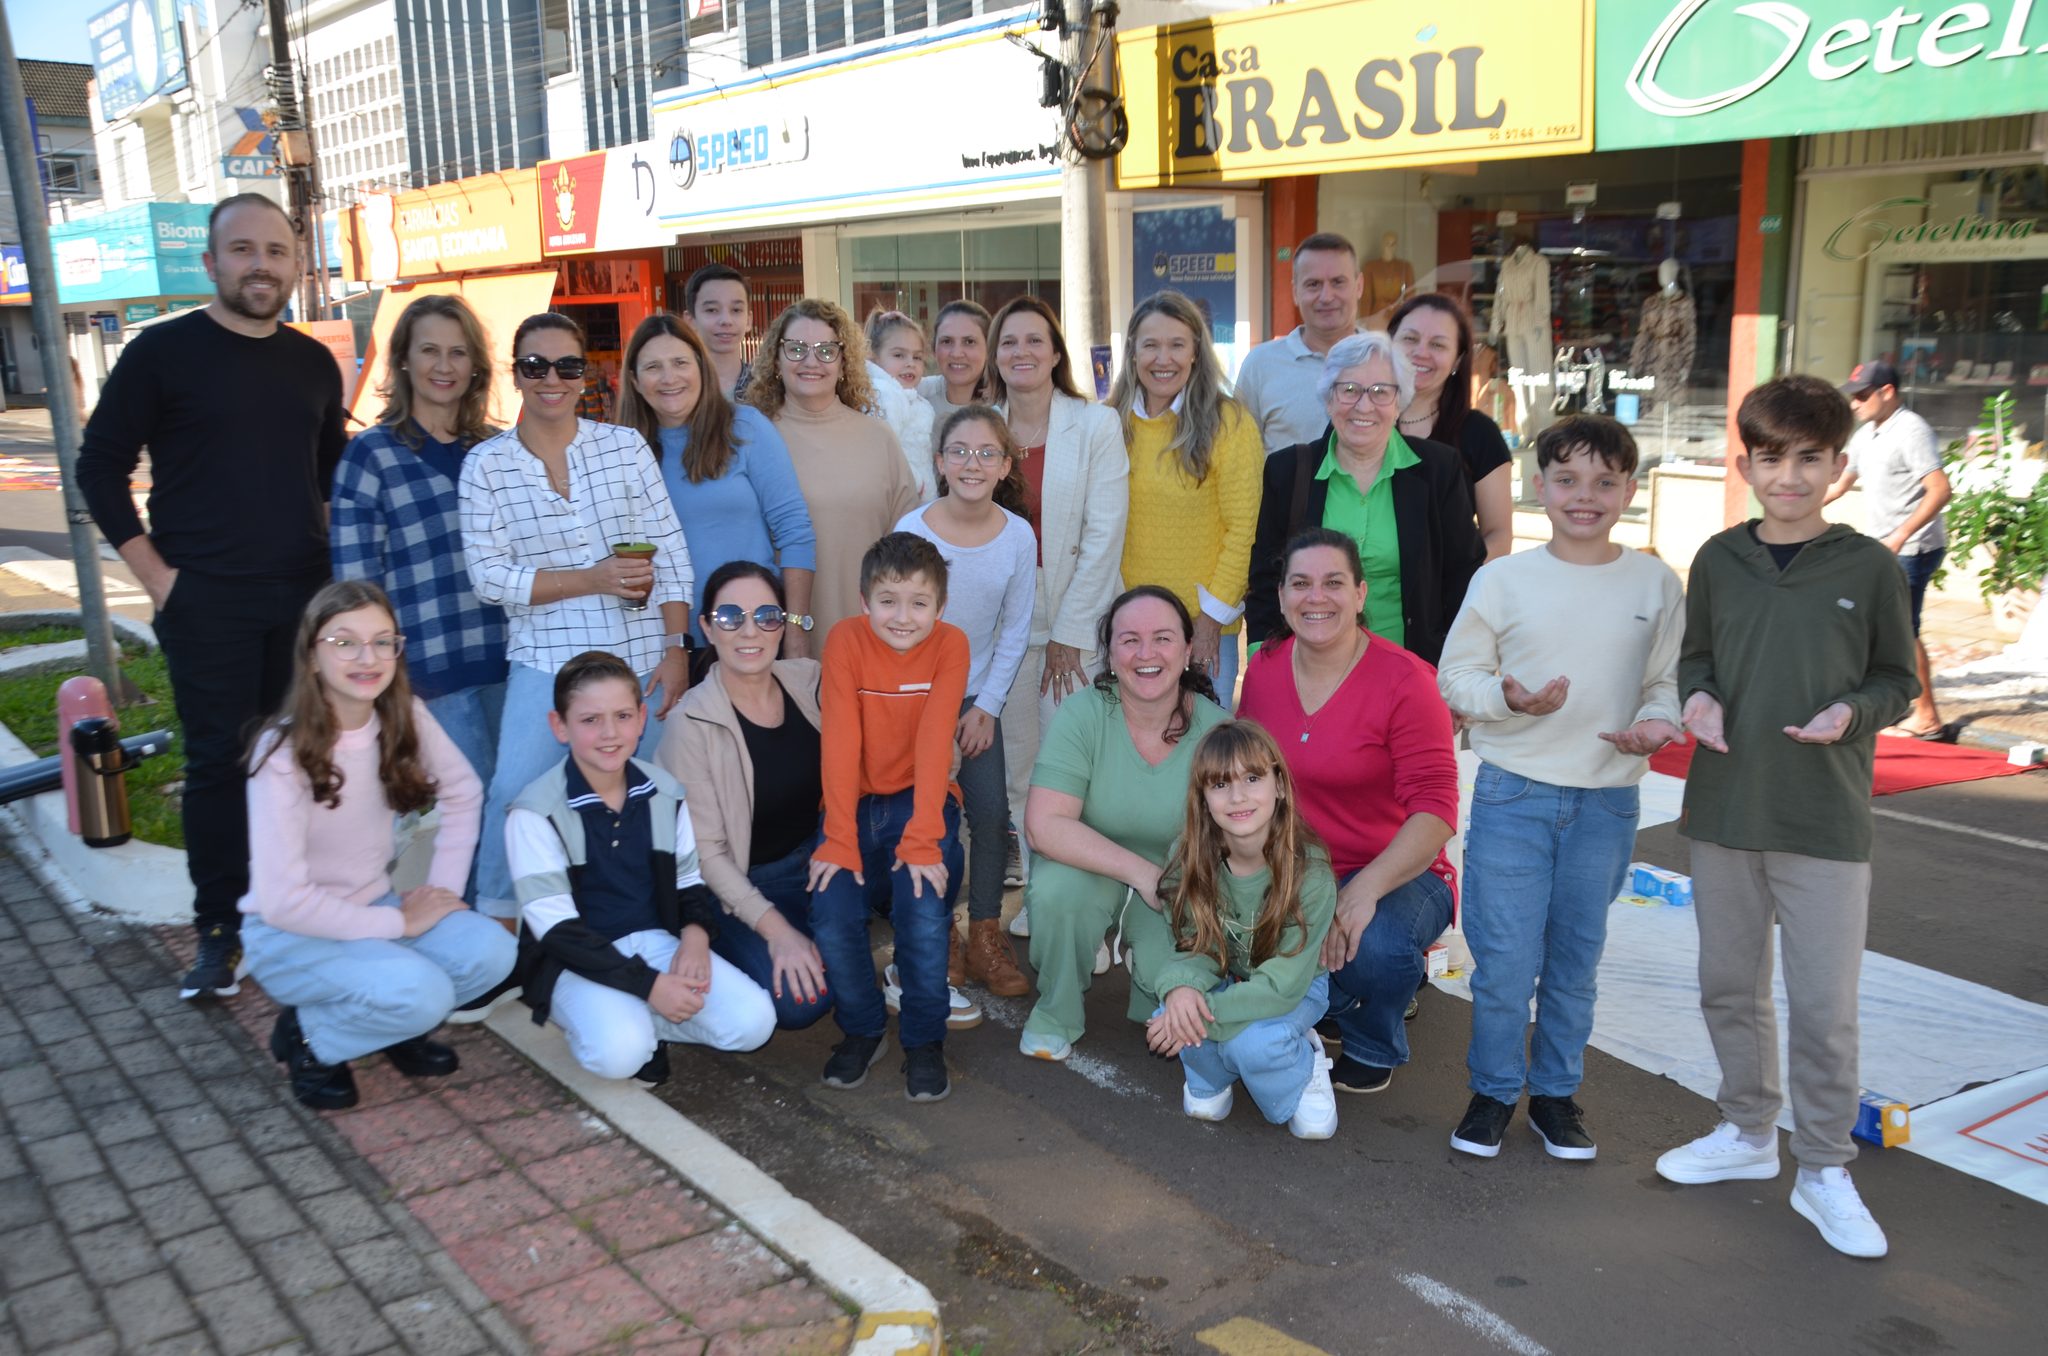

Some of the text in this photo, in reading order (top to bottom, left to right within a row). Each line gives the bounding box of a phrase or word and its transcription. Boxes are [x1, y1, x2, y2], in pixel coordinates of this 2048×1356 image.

[1173, 45, 1260, 82] Casa
[1625, 0, 2048, 118] Getel
[1174, 46, 1506, 159] BRASIL
[228, 159, 283, 177] CAIX
[697, 125, 769, 171] SPEED
[157, 222, 209, 239] Biom
[1822, 196, 2037, 262] Getelina
